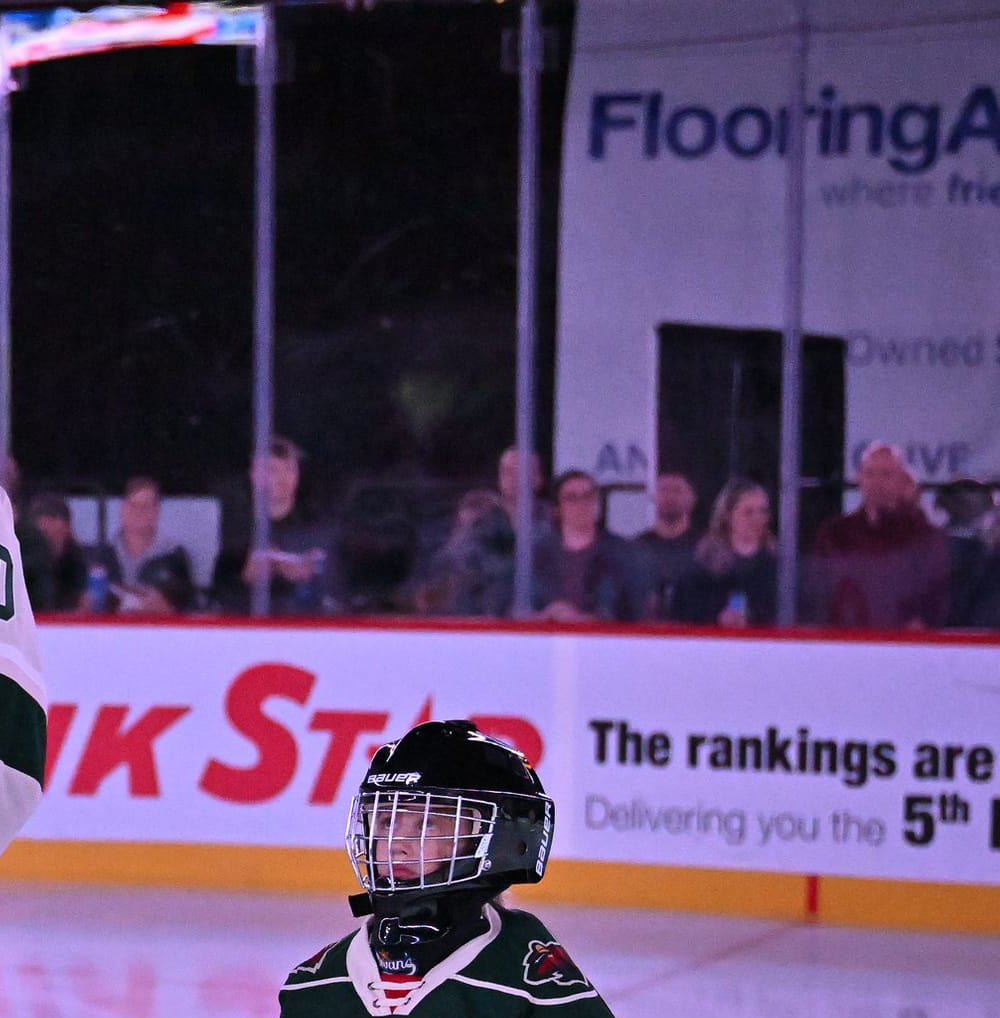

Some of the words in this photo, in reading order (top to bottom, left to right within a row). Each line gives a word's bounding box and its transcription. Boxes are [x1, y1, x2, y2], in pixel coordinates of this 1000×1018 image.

[588, 719, 671, 766] The
[687, 726, 898, 787] rankings
[913, 744, 994, 783] are
[367, 772, 422, 787] BAUER
[584, 794, 747, 846] Delivering
[757, 811, 820, 846] you
[831, 810, 888, 846] the
